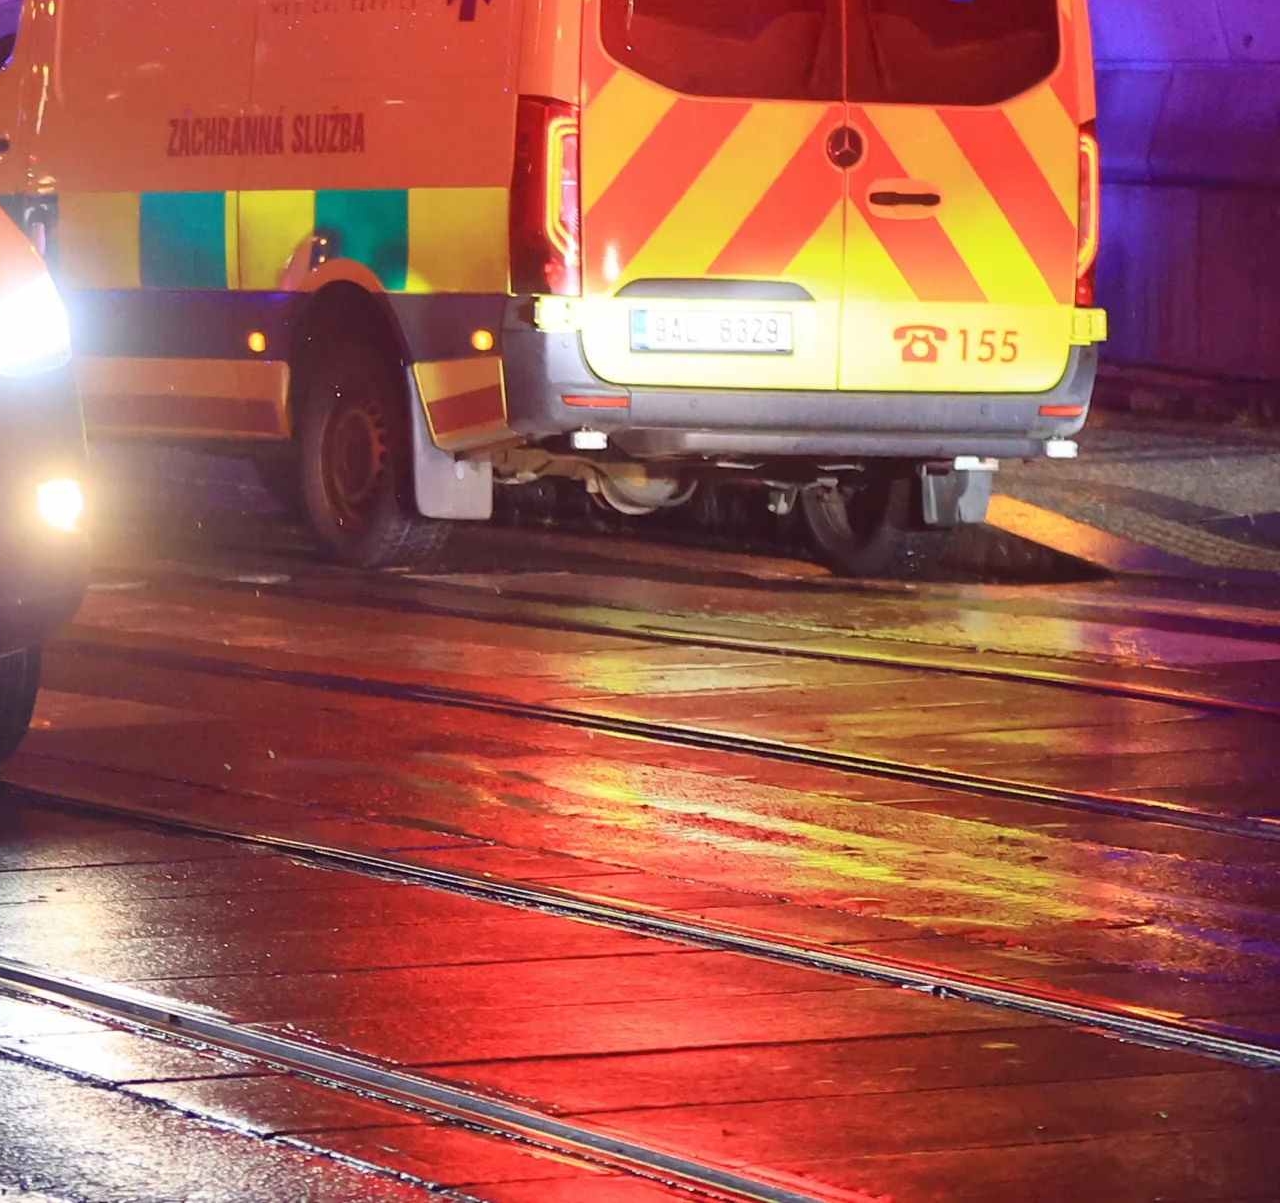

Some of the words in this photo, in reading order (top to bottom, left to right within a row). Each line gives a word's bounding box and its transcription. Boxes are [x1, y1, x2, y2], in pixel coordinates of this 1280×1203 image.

[167, 105, 285, 157] ZÁCHRANNÁ
[292, 104, 365, 155] SLUŽBA
[655, 317, 698, 342] 9AL
[720, 318, 779, 343] 8329
[958, 329, 1018, 363] 155
